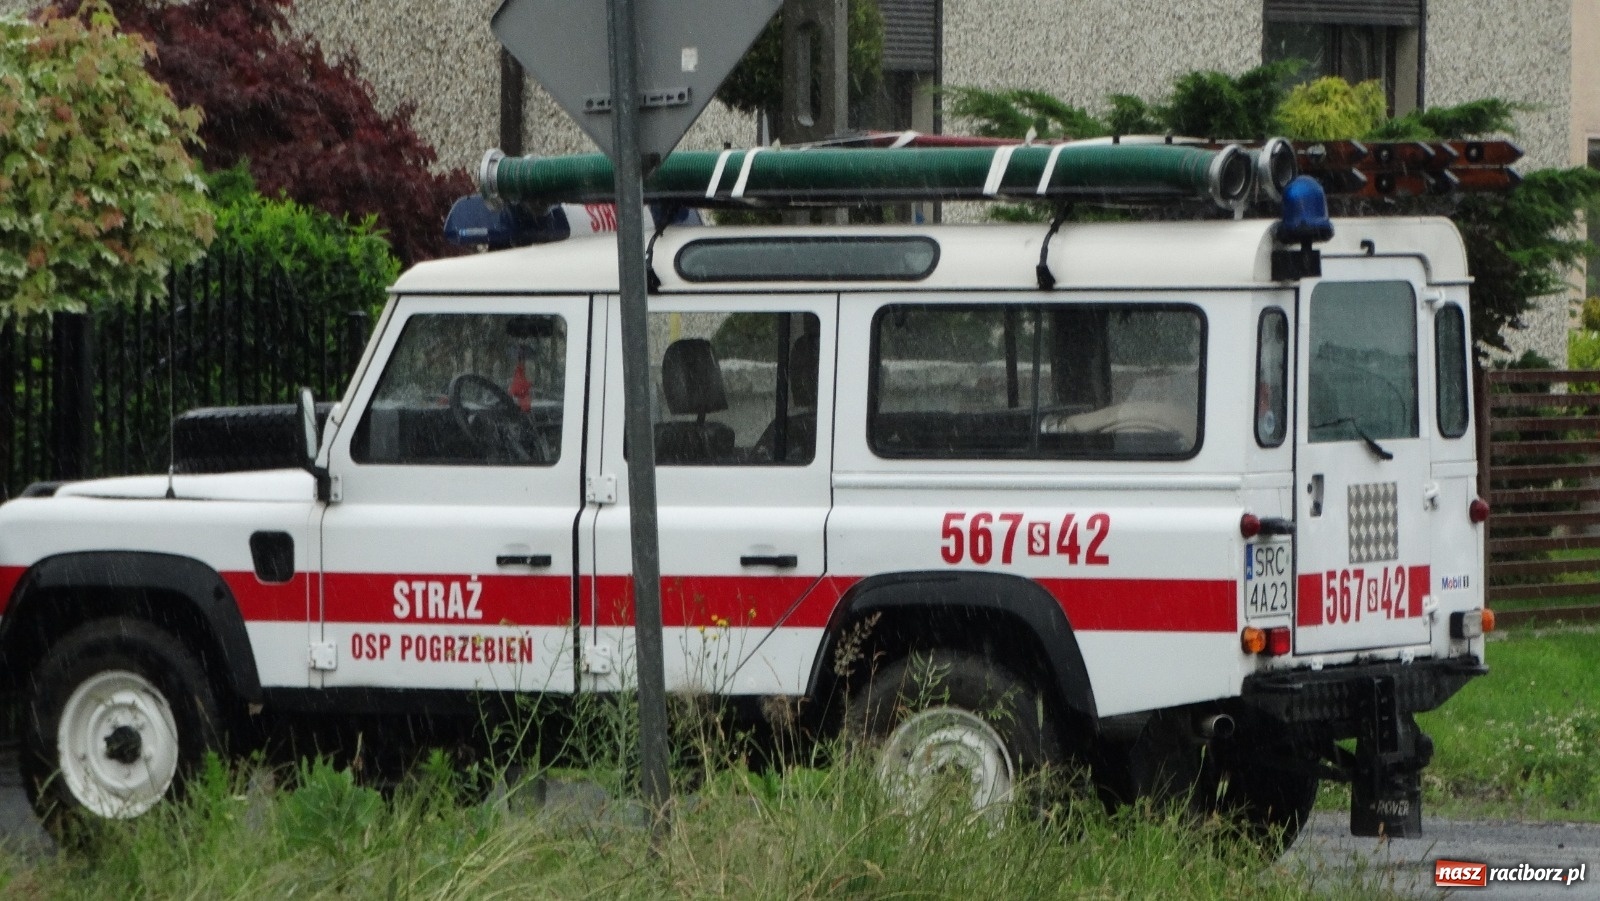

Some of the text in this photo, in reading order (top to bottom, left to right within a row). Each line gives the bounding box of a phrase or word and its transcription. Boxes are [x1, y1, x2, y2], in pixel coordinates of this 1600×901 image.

[1255, 546, 1285, 577] SRC
[392, 574, 484, 620] STRAŻ
[1250, 581, 1288, 613] 4A23
[1441, 576, 1462, 591] Mobil
[351, 630, 534, 664] OSP POGRZEBIEŃ
